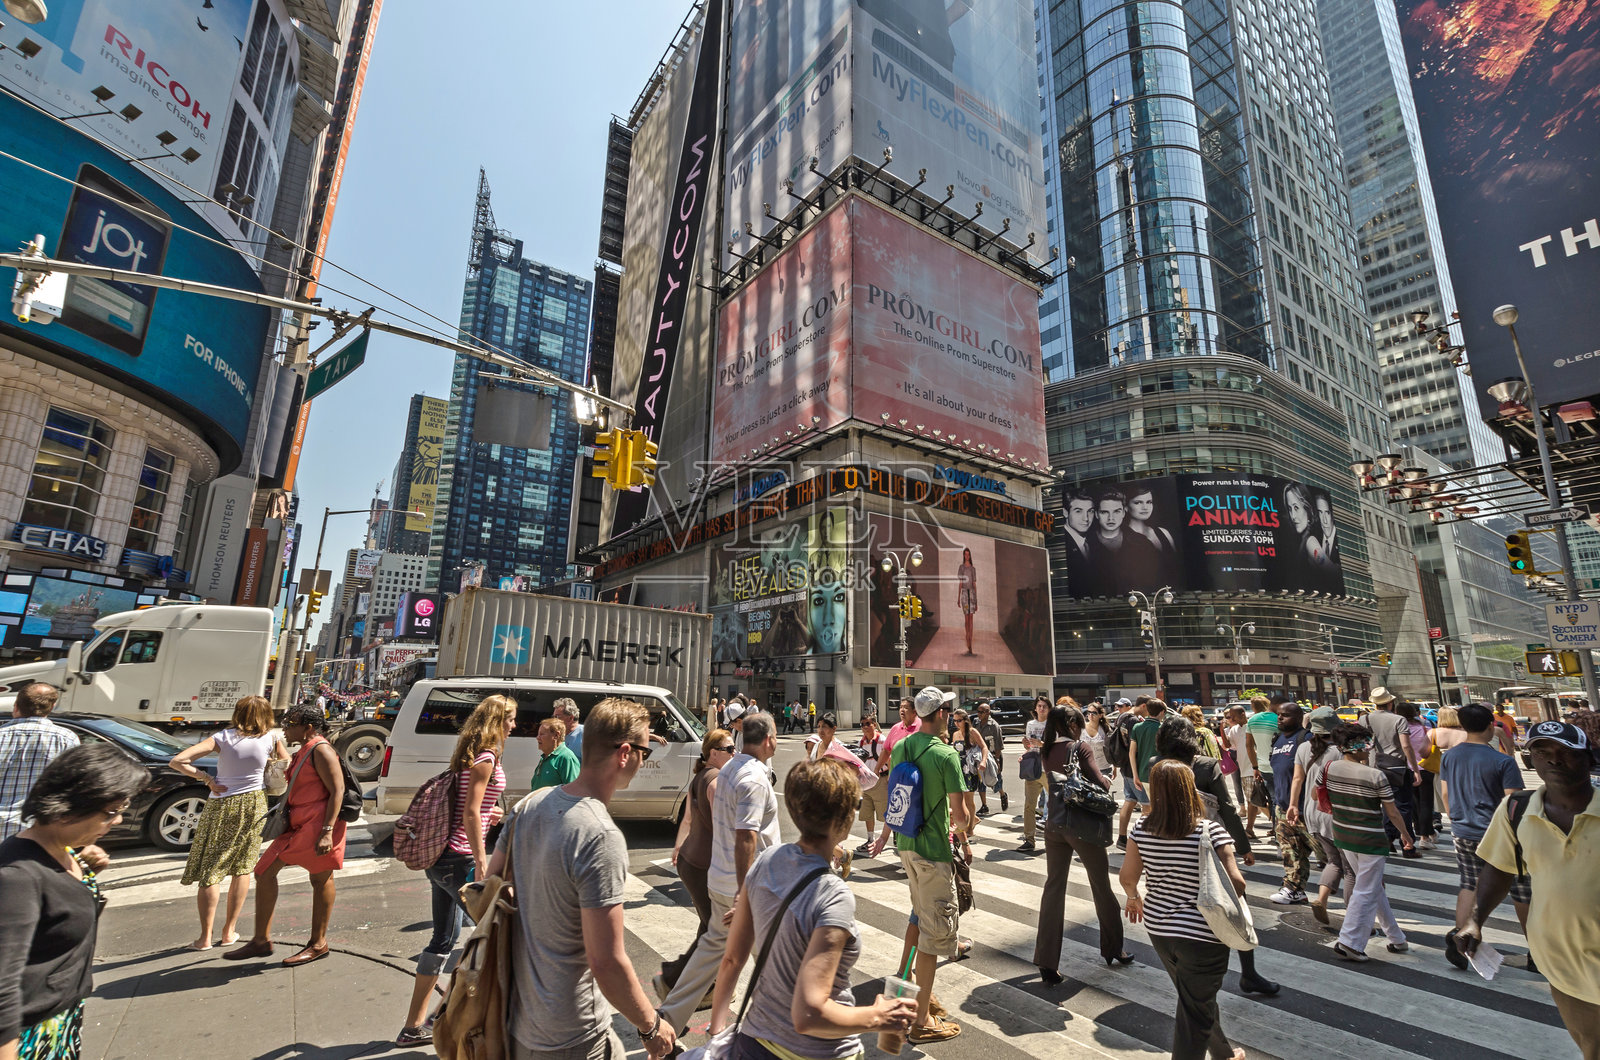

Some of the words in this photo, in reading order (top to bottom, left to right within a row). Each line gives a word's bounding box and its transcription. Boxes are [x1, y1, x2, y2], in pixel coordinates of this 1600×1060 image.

[14, 63, 48, 87] ONLY
[99, 45, 162, 103] imagine.
[166, 100, 208, 145] change.
[104, 24, 211, 130] RICOH
[730, 53, 847, 195] MyFlexPen.com
[872, 51, 1034, 182] MyFlexPen.com
[82, 210, 148, 273] jot
[630, 134, 707, 493] EAUTY.COM
[868, 283, 1034, 372] PROMGIRL.COM
[719, 281, 846, 388] PROMGIRL.COM
[893, 321, 912, 338] The
[914, 331, 945, 352] Online
[947, 344, 970, 362] Prom
[971, 354, 1016, 381] Superstore
[184, 333, 214, 366] FOR
[214, 356, 246, 396] IPHONE
[323, 364, 332, 384] 7
[732, 379, 744, 393] The
[744, 366, 765, 385] Online
[765, 355, 784, 373] Prom
[784, 325, 826, 360] Superstore
[422, 410, 448, 420] NOTHIN
[725, 429, 739, 445] Your
[740, 417, 759, 437] dress
[759, 415, 766, 425] is
[766, 406, 781, 424] just
[788, 390, 807, 410] click
[808, 379, 831, 398] away
[904, 381, 920, 398] It's
[922, 389, 934, 402] all
[936, 394, 964, 413] about
[966, 404, 986, 420] your
[988, 411, 1012, 429] dress
[869, 468, 906, 499] PLUG
[915, 480, 969, 514] OLYMPIC
[976, 495, 1029, 528] SECURITY
[1034, 511, 1055, 533] GAP
[1185, 494, 1279, 513] POLITICAL
[1251, 480, 1270, 489] family.
[705, 517, 720, 539] HAS
[763, 488, 790, 520] MORE
[795, 473, 824, 506] THAN
[1188, 509, 1280, 528] ANIMALS
[1533, 514, 1551, 523] ONE
[1559, 510, 1579, 519] WAY
[21, 526, 107, 558] CHAS
[209, 542, 227, 591] THOMSON
[220, 498, 236, 541] REUTERS
[1203, 535, 1251, 543] SUNDAYS
[1252, 535, 1275, 545] 10PM
[243, 569, 255, 600] THOMSON
[249, 541, 261, 570] REUTERS
[414, 617, 431, 627] LG
[748, 609, 771, 622] BEGINS
[748, 621, 763, 631] JUNE
[764, 620, 771, 630] 18
[1551, 624, 1598, 634] SECURITY
[1555, 603, 1589, 615] NYPD
[542, 634, 684, 669] MAERSK
[747, 632, 762, 644] HBO
[1555, 632, 1597, 643] CAMERA
